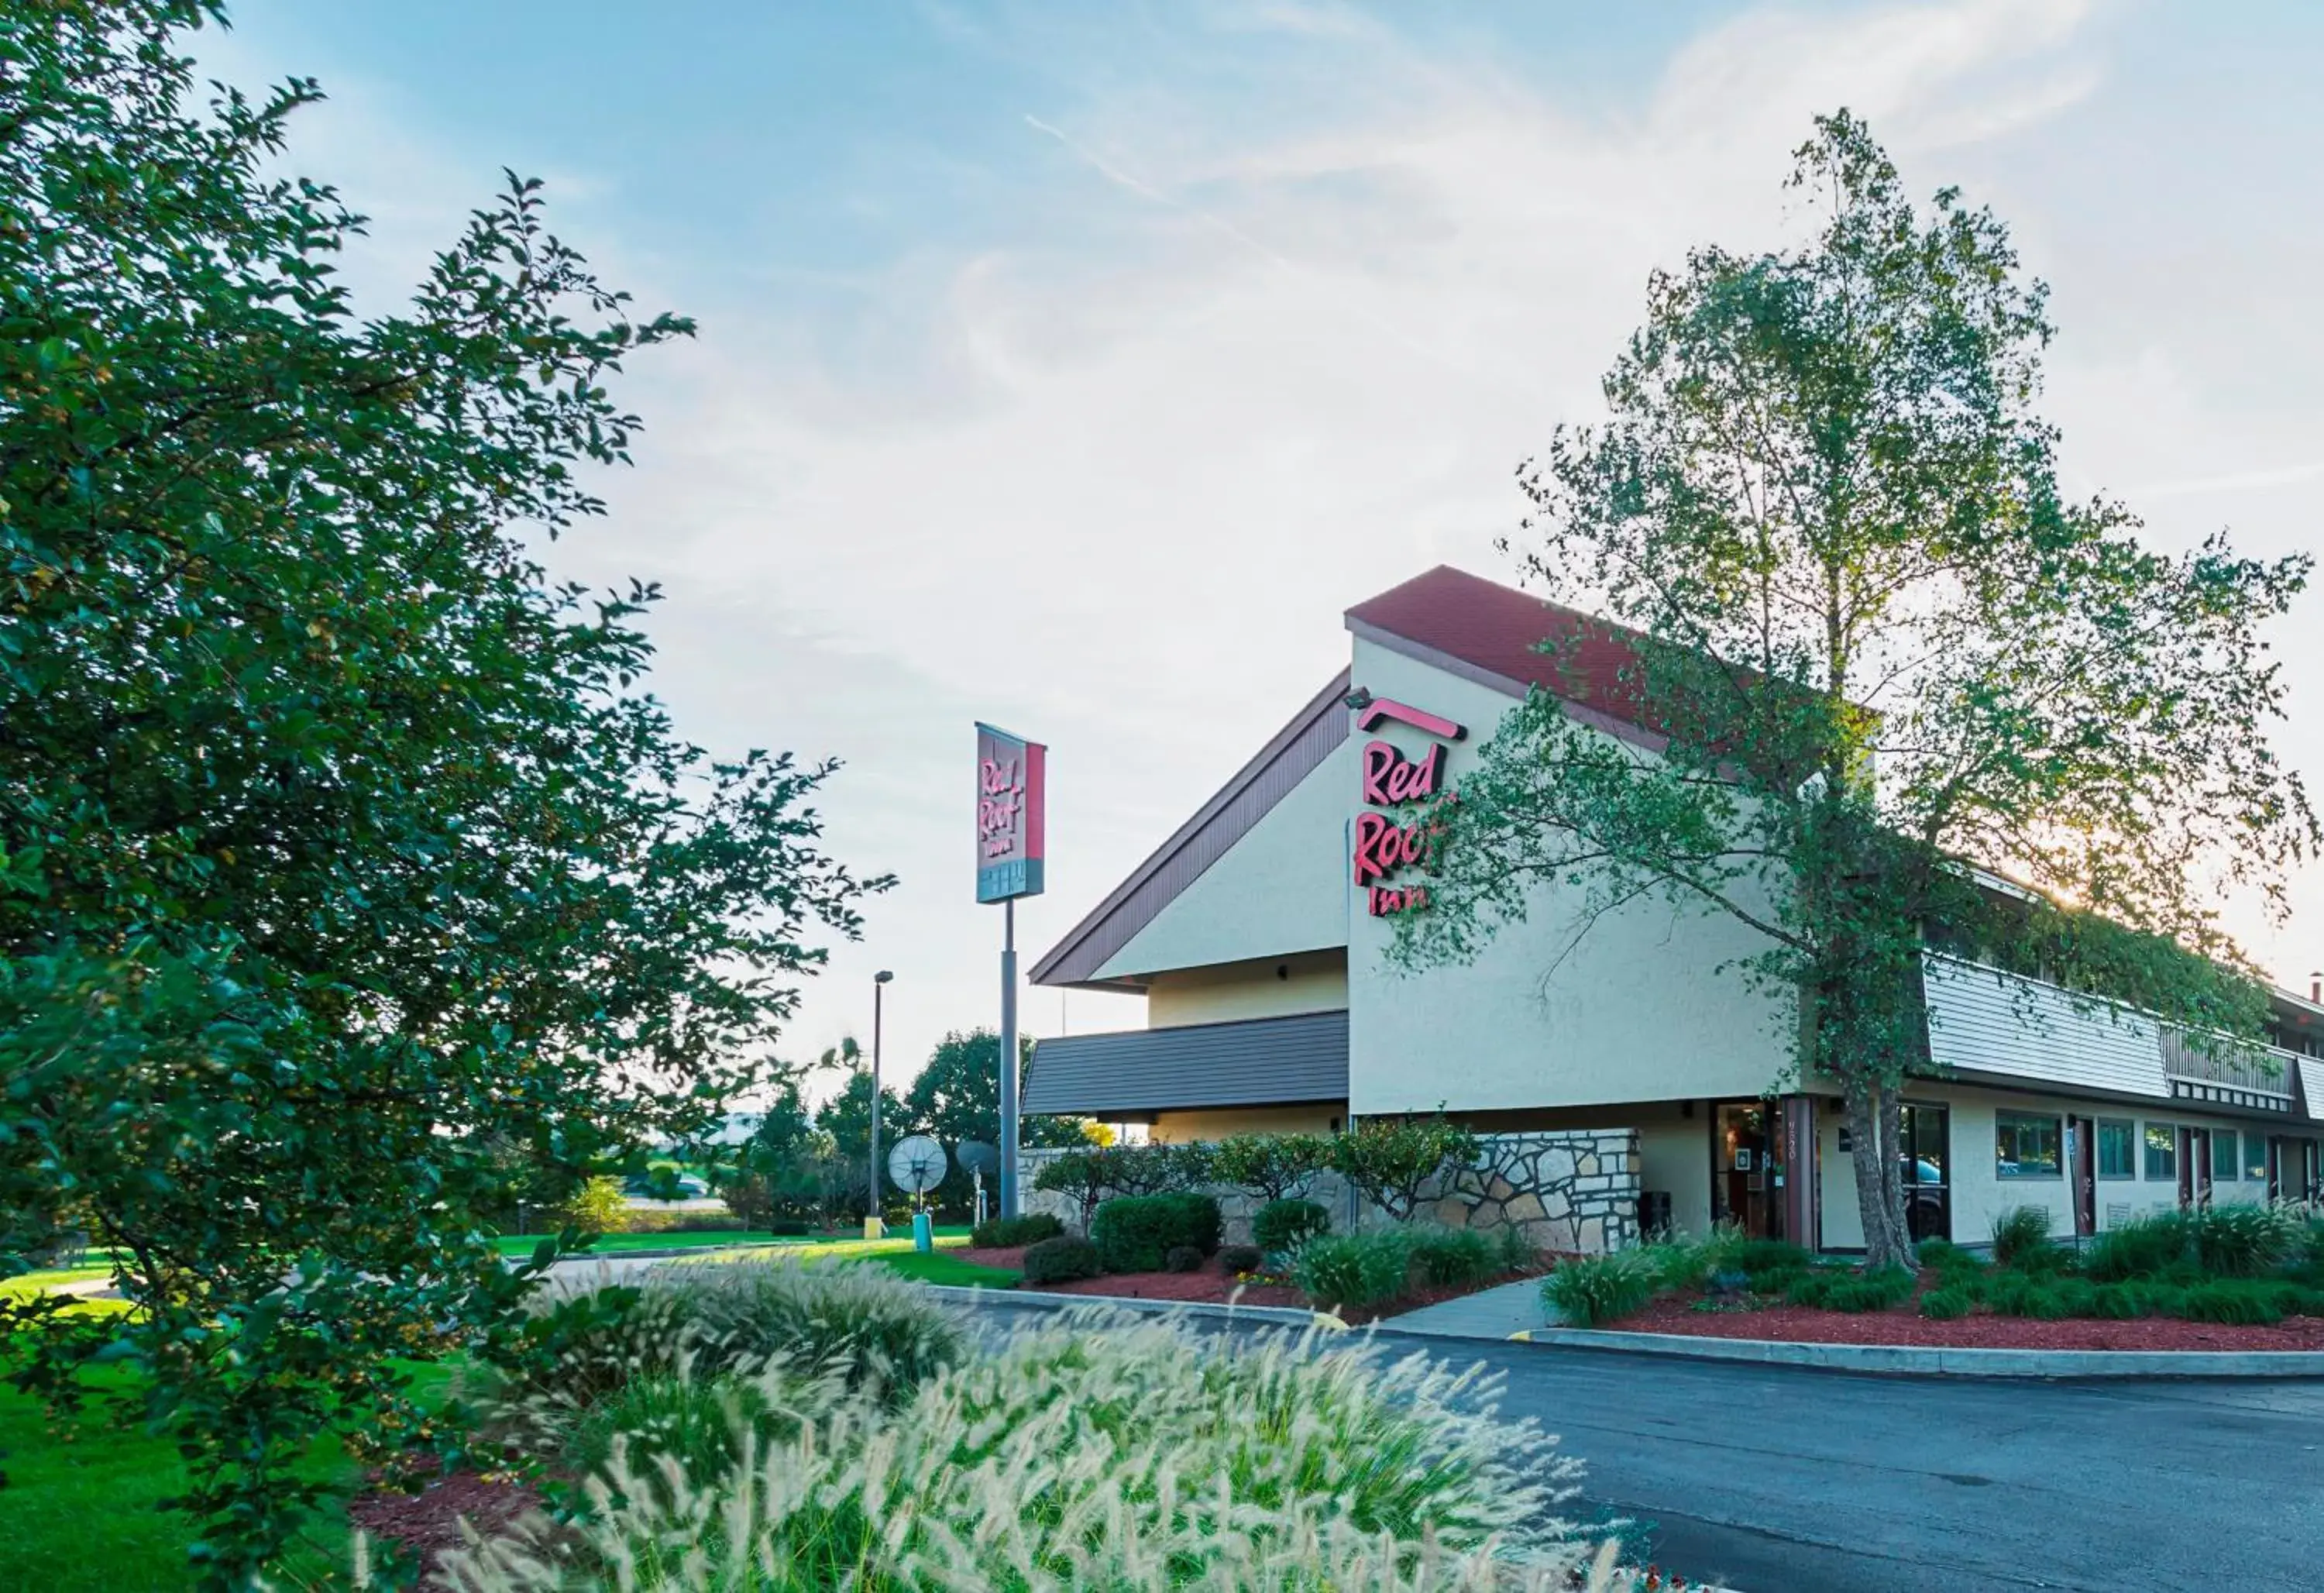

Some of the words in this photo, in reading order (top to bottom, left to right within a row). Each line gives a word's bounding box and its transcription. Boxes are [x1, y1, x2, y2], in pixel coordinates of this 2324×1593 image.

[1363, 740, 1443, 806] Red
[1353, 796, 1453, 886] Roo
[1369, 885, 1429, 917] Inn
